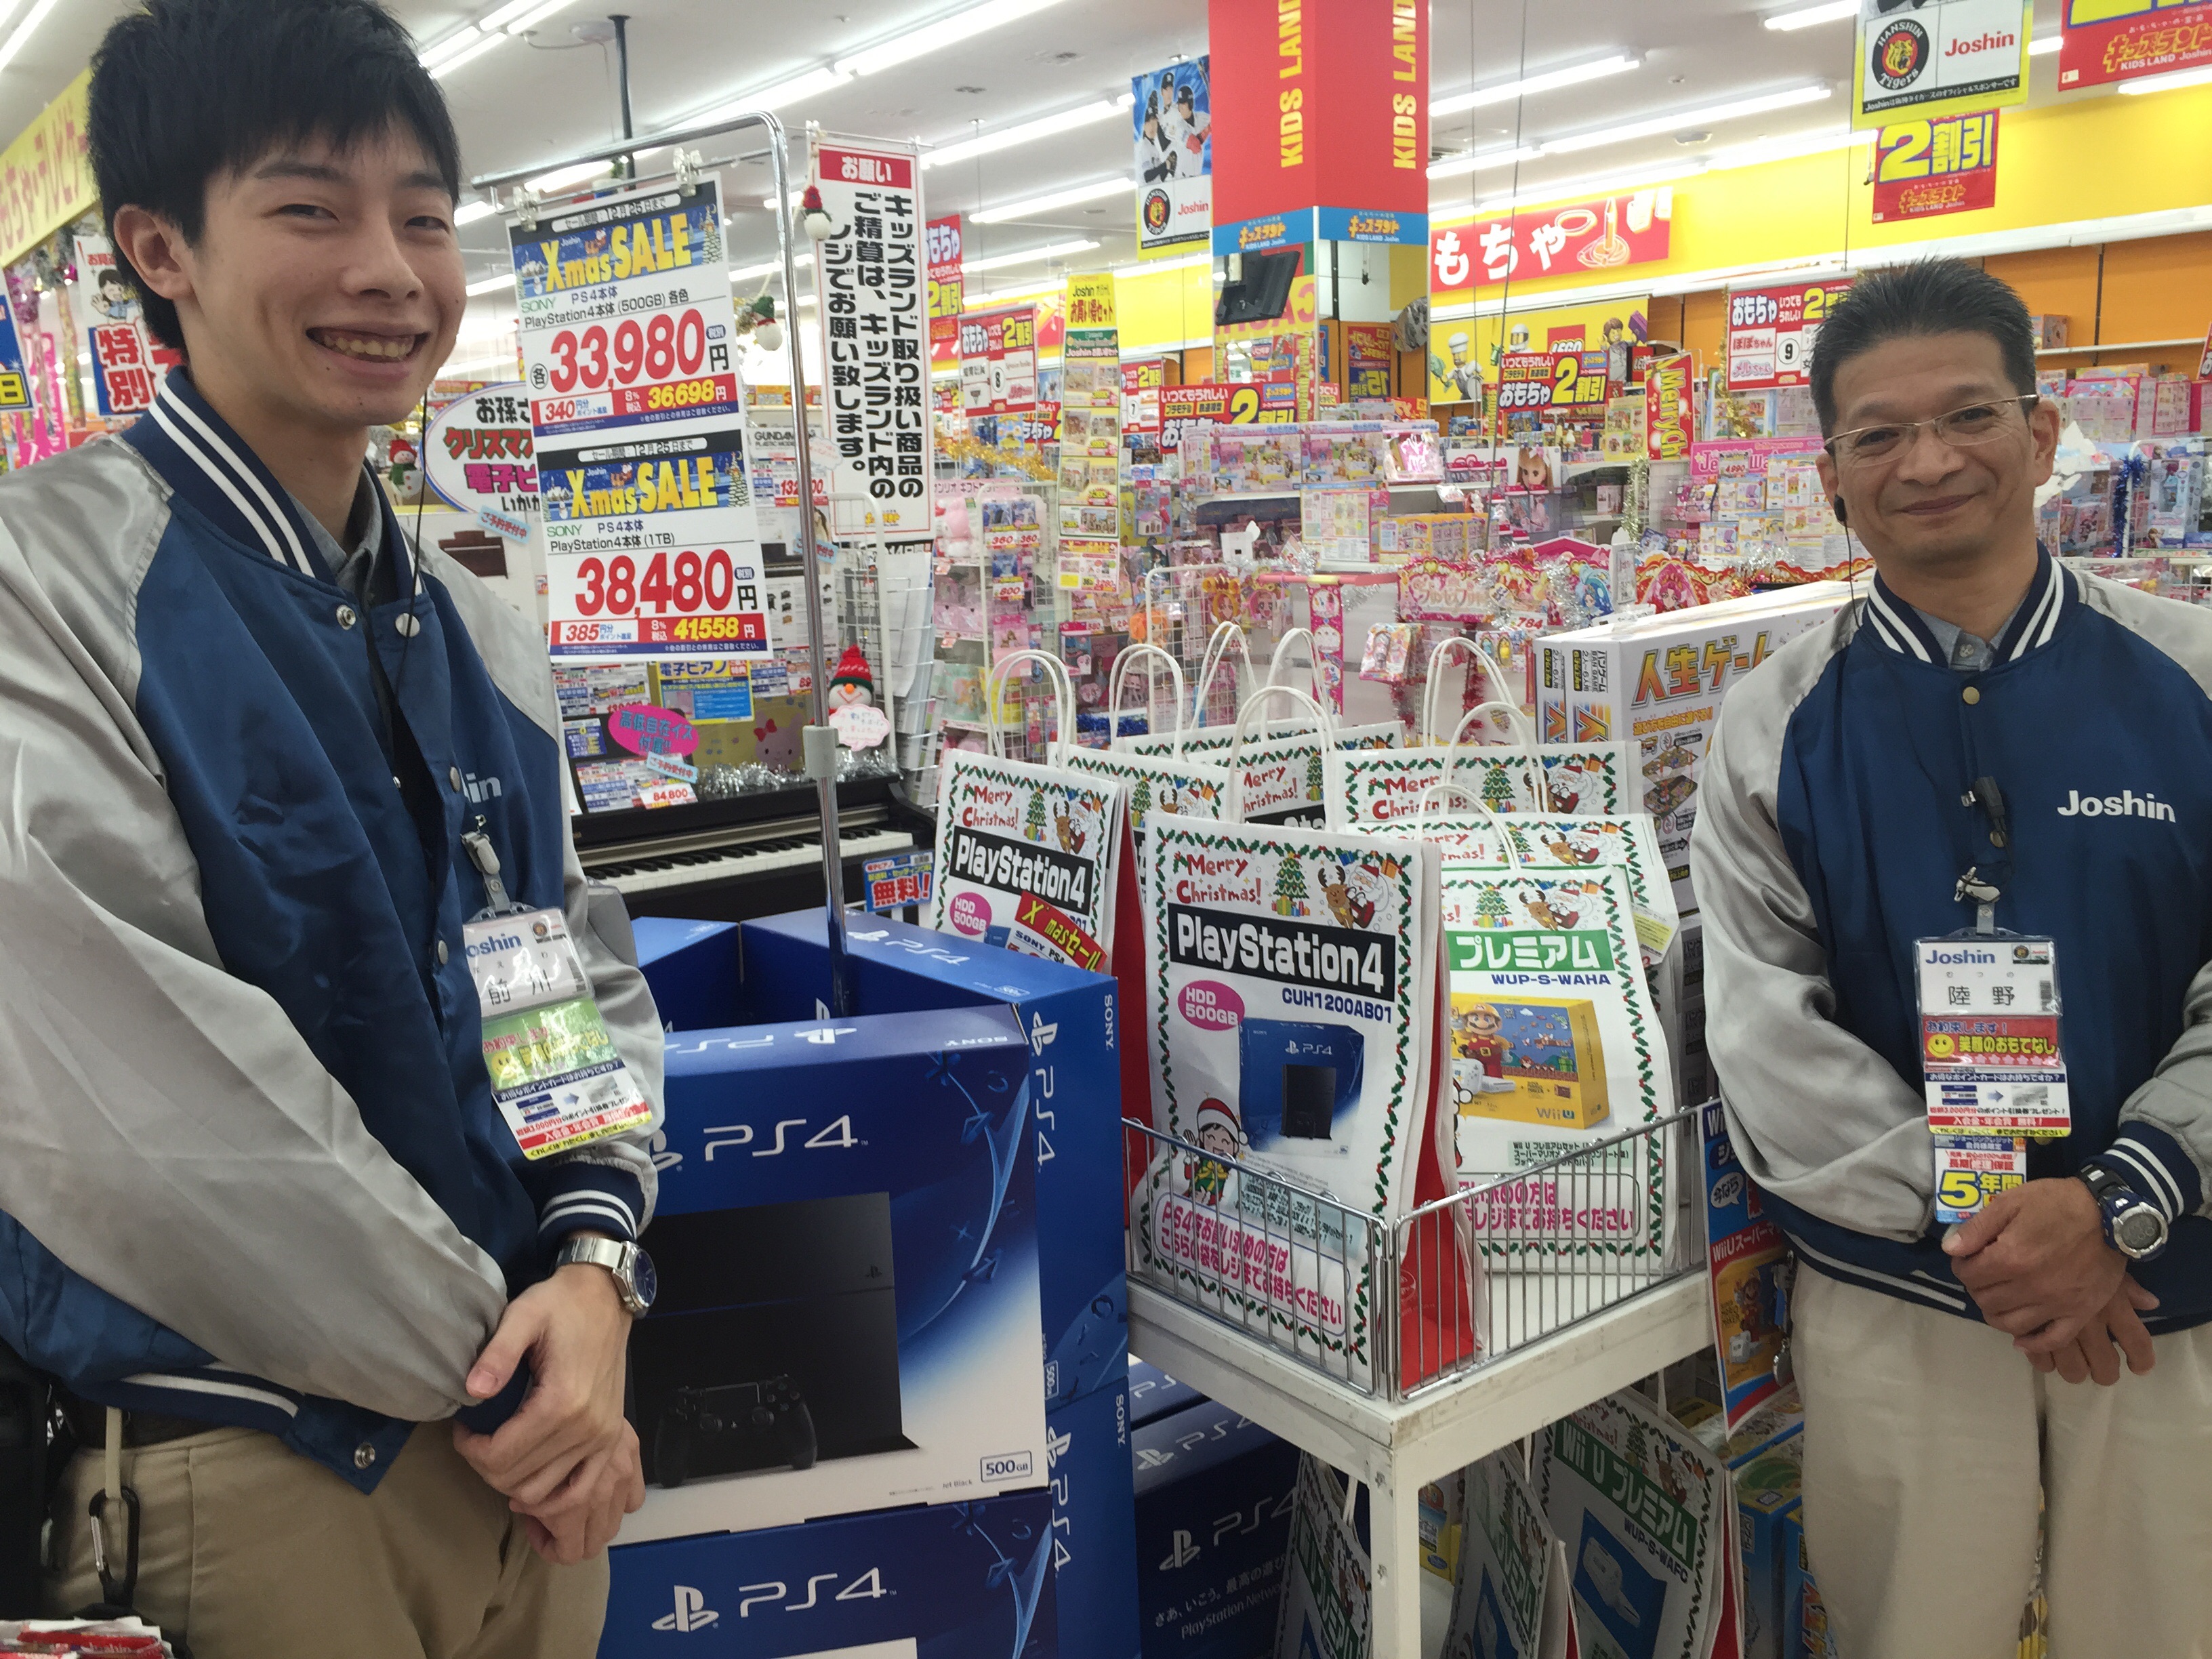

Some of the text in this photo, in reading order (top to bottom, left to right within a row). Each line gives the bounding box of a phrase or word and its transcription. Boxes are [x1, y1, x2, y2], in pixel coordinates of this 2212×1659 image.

[1878, 22, 1923, 47] HANSHIN
[1944, 30, 2015, 57] Joshin
[2121, 48, 2212, 71] KIDS LAND Joshin
[1880, 68, 1919, 89] Tigers
[1279, 88, 1303, 168] KIDS
[1393, 93, 1416, 169] KIDS
[1879, 113, 1994, 184] 2割引
[841, 155, 893, 183] お願い
[1178, 201, 1209, 216] Joshin
[611, 213, 693, 279] SALE
[521, 297, 556, 313] SONY
[571, 285, 618, 304] PS4本体
[525, 288, 690, 329] PlayStation4本体 (500GB) 各色
[1732, 295, 1778, 327] おもちゃ
[550, 308, 705, 393] 33,980
[709, 343, 730, 372] 円
[884, 194, 924, 499] キッズランド取り扱い商品の
[1784, 343, 1793, 360] 9
[97, 328, 150, 407] 特別
[1501, 356, 1555, 369] いつでもうれしい
[624, 390, 640, 401] 8%
[647, 378, 716, 410] 36,698
[716, 386, 727, 401] 円
[1161, 387, 1229, 403] いつでもうれしい
[1499, 382, 1551, 407] おもちゃ
[545, 399, 575, 421] 340
[637, 456, 718, 513] SALE
[547, 524, 582, 537] SONY
[597, 519, 644, 534] PS4本体
[550, 532, 676, 553] PlayStation4本体 (1TB)
[575, 548, 734, 619] 38,480
[737, 585, 758, 611] 円
[566, 623, 600, 642] 385
[674, 617, 739, 642] 41,558
[743, 623, 756, 639] 円
[1517, 617, 1543, 629] 784
[973, 785, 1012, 806] Merry
[1243, 777, 1298, 814] hristmas!
[2057, 790, 2177, 823] Joshin
[962, 806, 1019, 830] Christmas!
[955, 834, 1086, 909] PlayStation4
[1186, 853, 1248, 877] Merry
[872, 873, 930, 907] 無料！
[1176, 878, 1262, 905] Christmas!
[955, 897, 976, 912] HDD
[953, 912, 987, 933] 500GB
[466, 934, 522, 958] oshin
[885, 938, 970, 966] PS4
[1015, 930, 1046, 951] SONY
[1176, 912, 1385, 994] PlayStation4
[1455, 935, 1601, 970] プレミアム
[1925, 949, 1996, 964] Joshin
[1490, 974, 1611, 986] WUP-S-WAHA
[1185, 987, 1216, 1006] HDD
[1948, 985, 2015, 1006] 陸 野
[1104, 994, 1114, 1051] SONY
[1185, 1002, 1240, 1025] 500GB
[1302, 1044, 1332, 1055] PS4
[1959, 1036, 2055, 1055] 笑顔のおもてなし
[1034, 1065, 1056, 1168] PS4
[1536, 1107, 1560, 1120] Wii
[703, 1114, 859, 1162] PS4
[1115, 1393, 1126, 1448] SONY
[1563, 1420, 1688, 1561] Wii U プレミアム
[1050, 1475, 1072, 1571] PS4
[1623, 1517, 1689, 1584] WUP-S-WAFC
[739, 1566, 887, 1618] PS4
[1181, 1599, 1244, 1639] PlayStation
